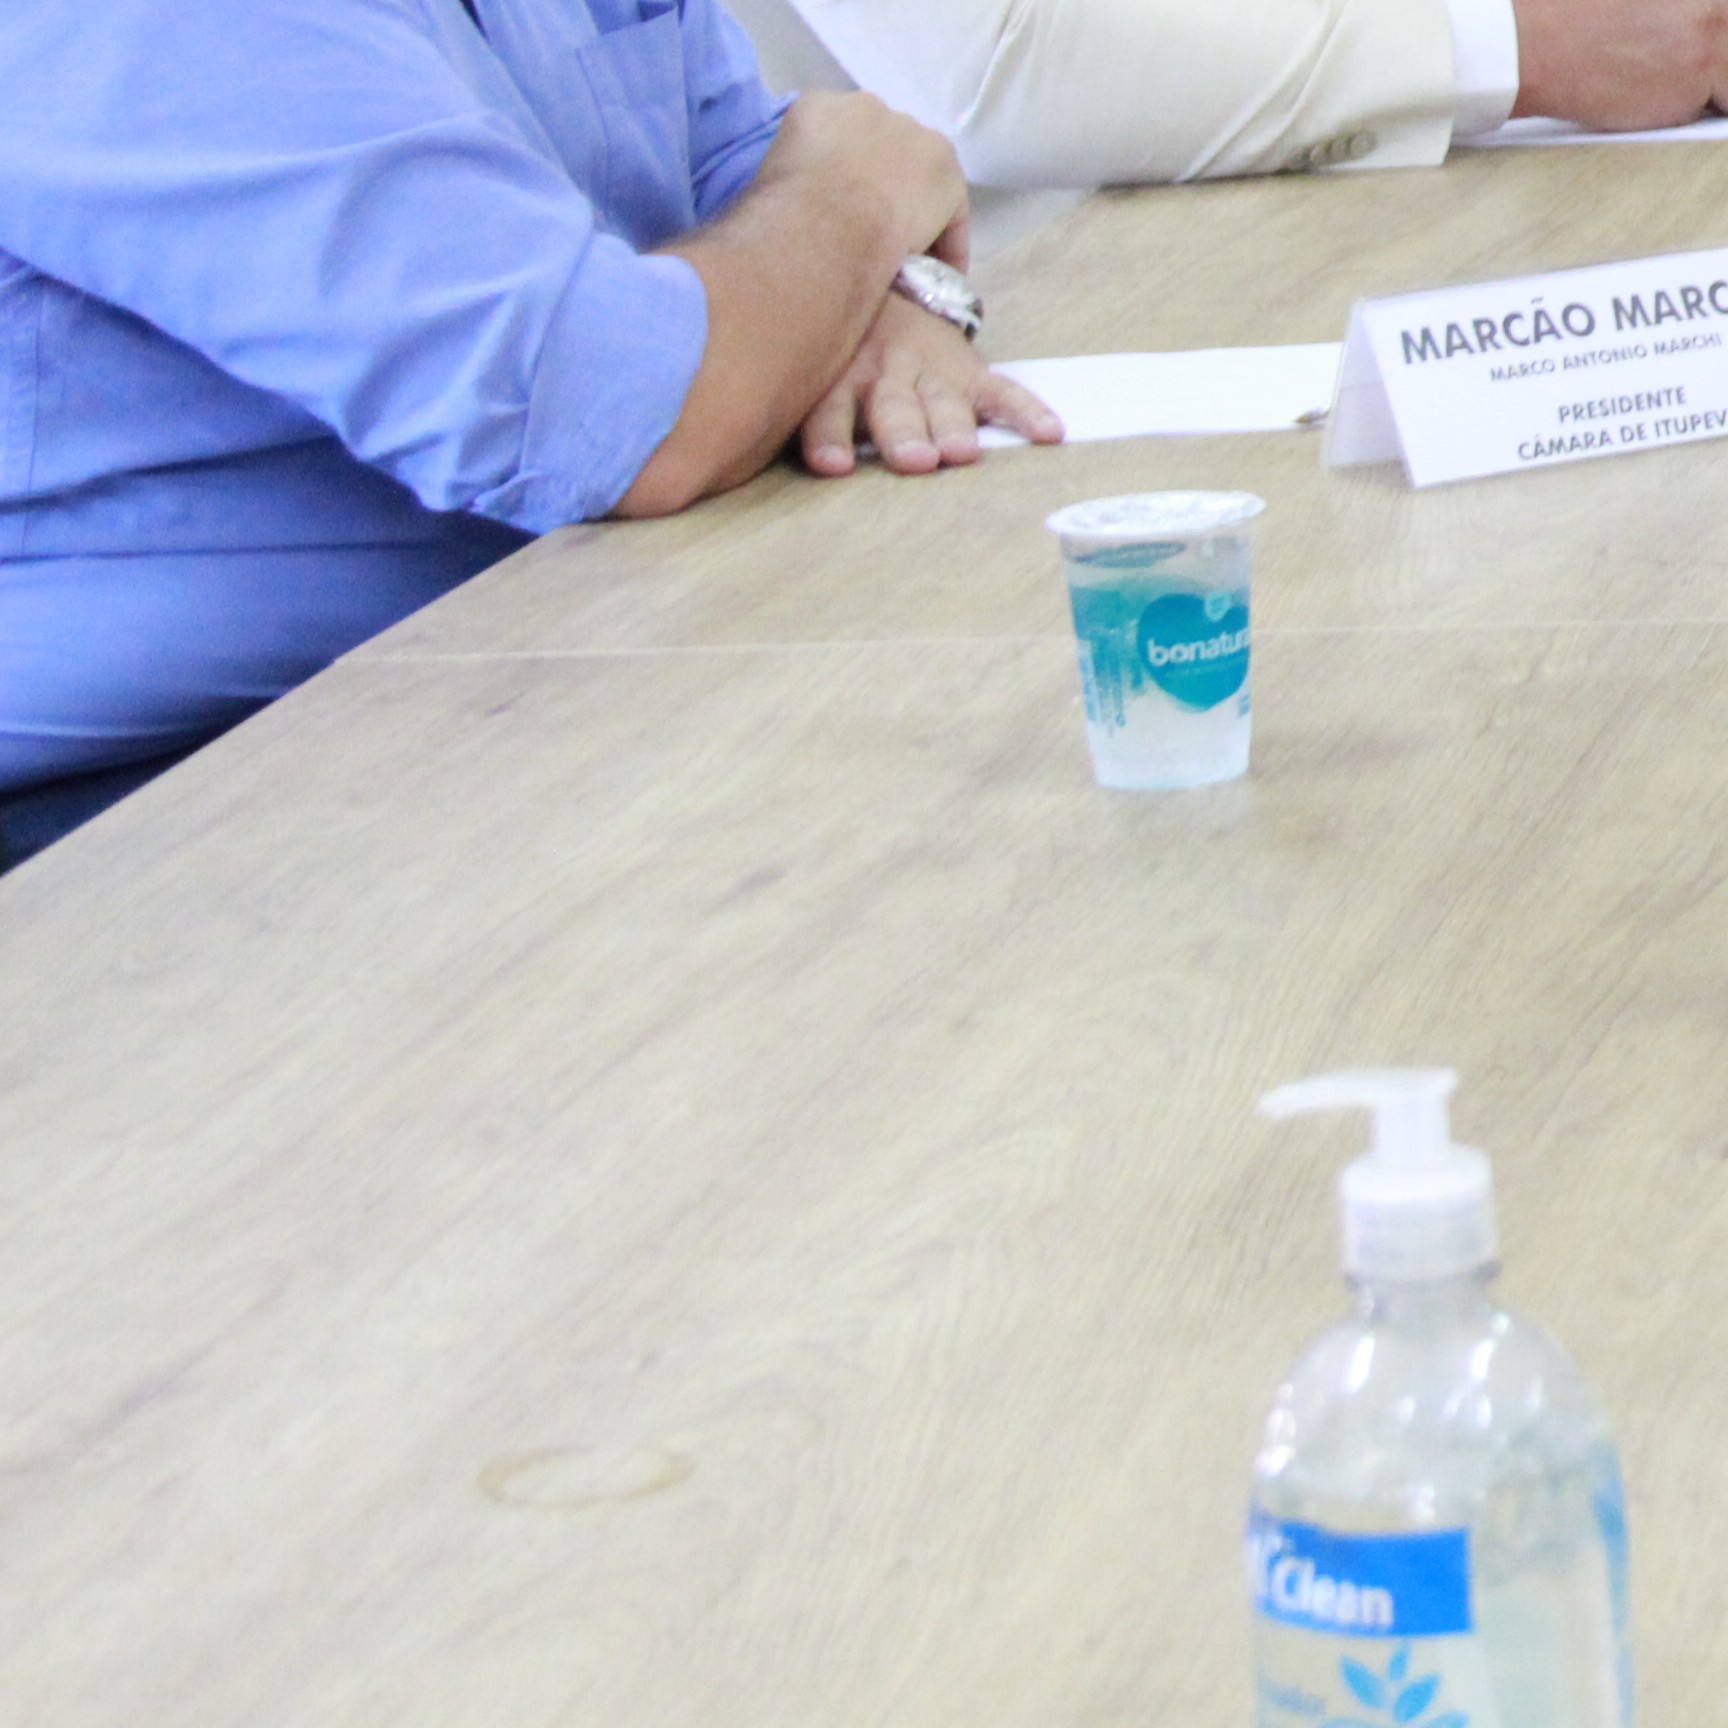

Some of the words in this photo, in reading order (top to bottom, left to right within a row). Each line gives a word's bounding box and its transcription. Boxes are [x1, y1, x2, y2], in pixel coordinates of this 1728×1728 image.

[1400, 296, 1597, 365] MARCÃO
[1490, 358, 1556, 382] MARCO
[1563, 342, 1648, 371] ANTONIO
[1653, 332, 1723, 360] MARCHI
[1558, 385, 1687, 424] PRESIDENTE
[1518, 427, 1614, 461] CÂMARA
[1619, 421, 1648, 444] DE
